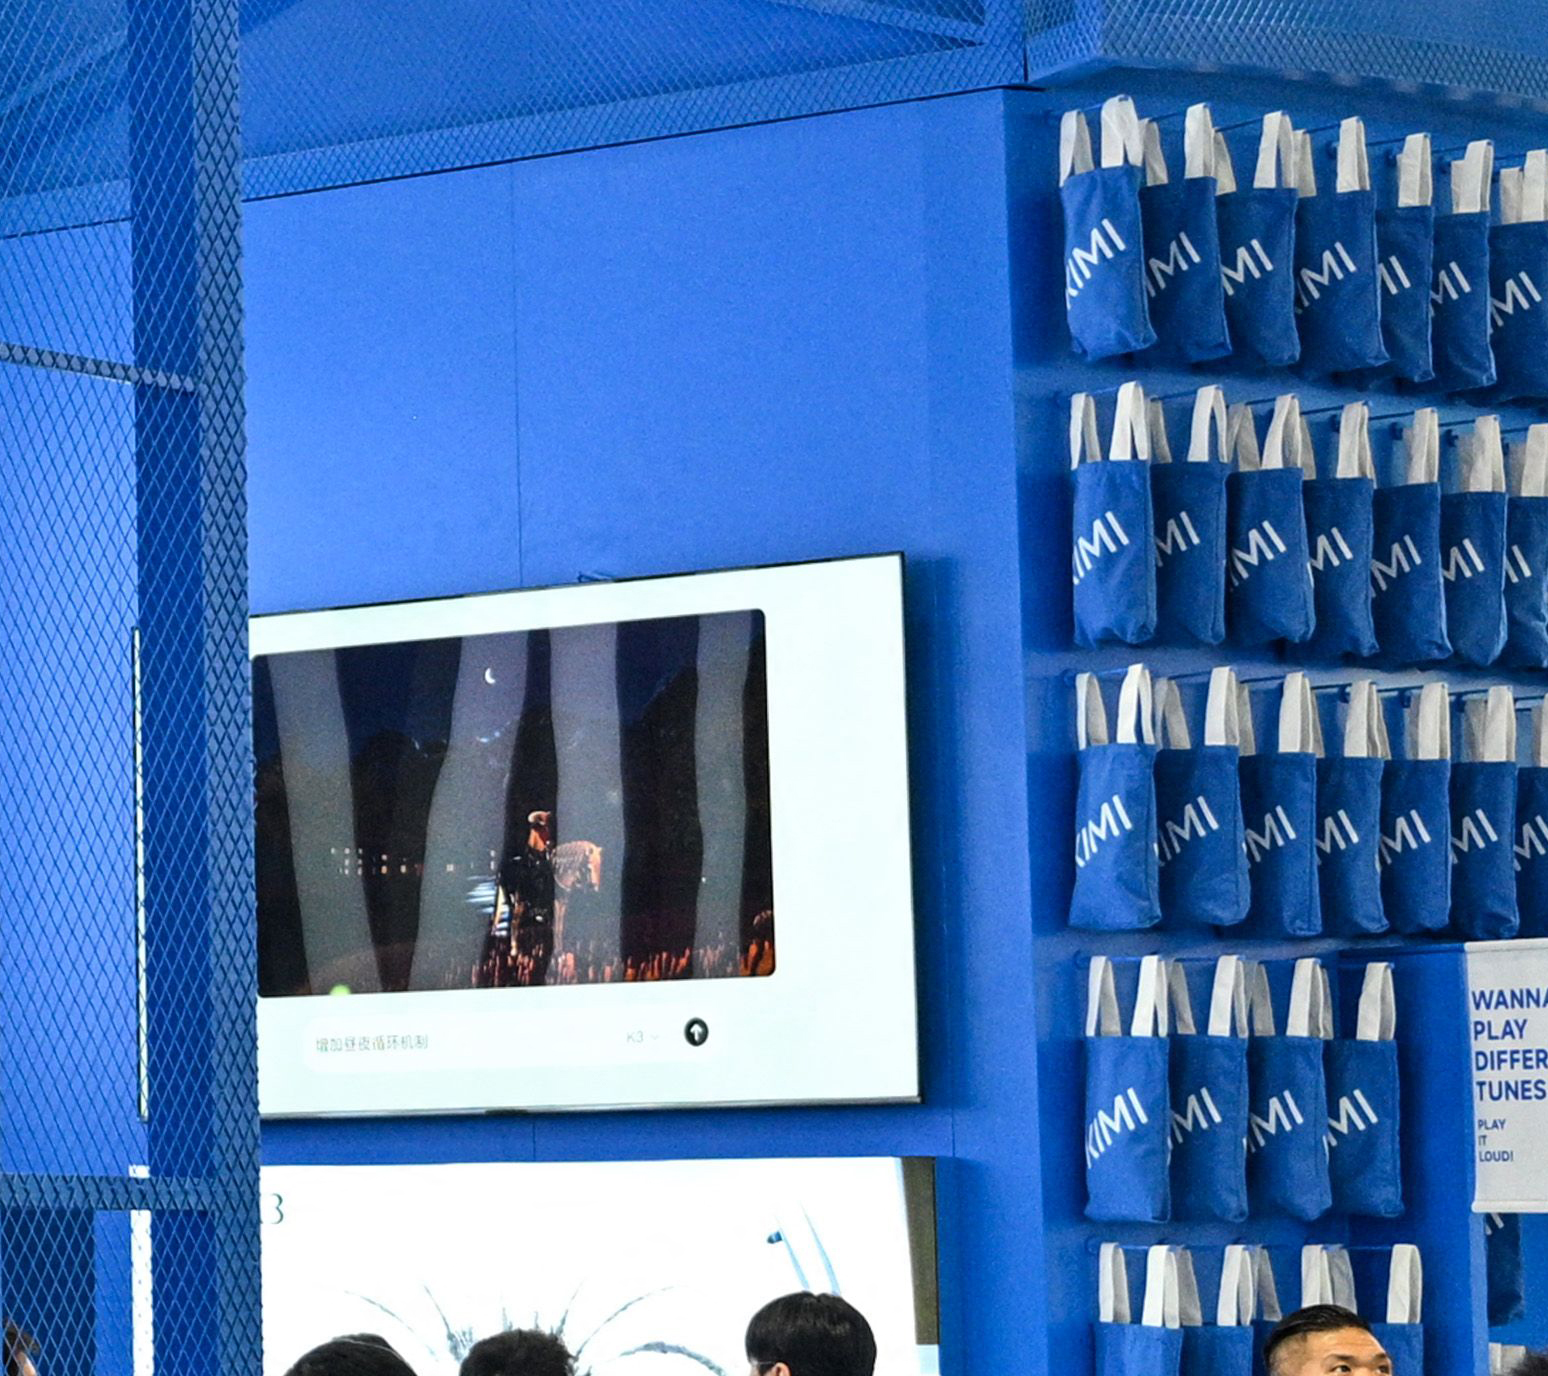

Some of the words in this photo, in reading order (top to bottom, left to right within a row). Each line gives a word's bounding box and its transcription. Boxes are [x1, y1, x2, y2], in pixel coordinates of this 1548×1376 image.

[1474, 1019, 1528, 1040] PLAY
[1476, 1080, 1547, 1101] TUNES
[1478, 1119, 1506, 1130] PLAY
[1478, 1136, 1487, 1146] IT
[1479, 1151, 1514, 1162] LOUD!
